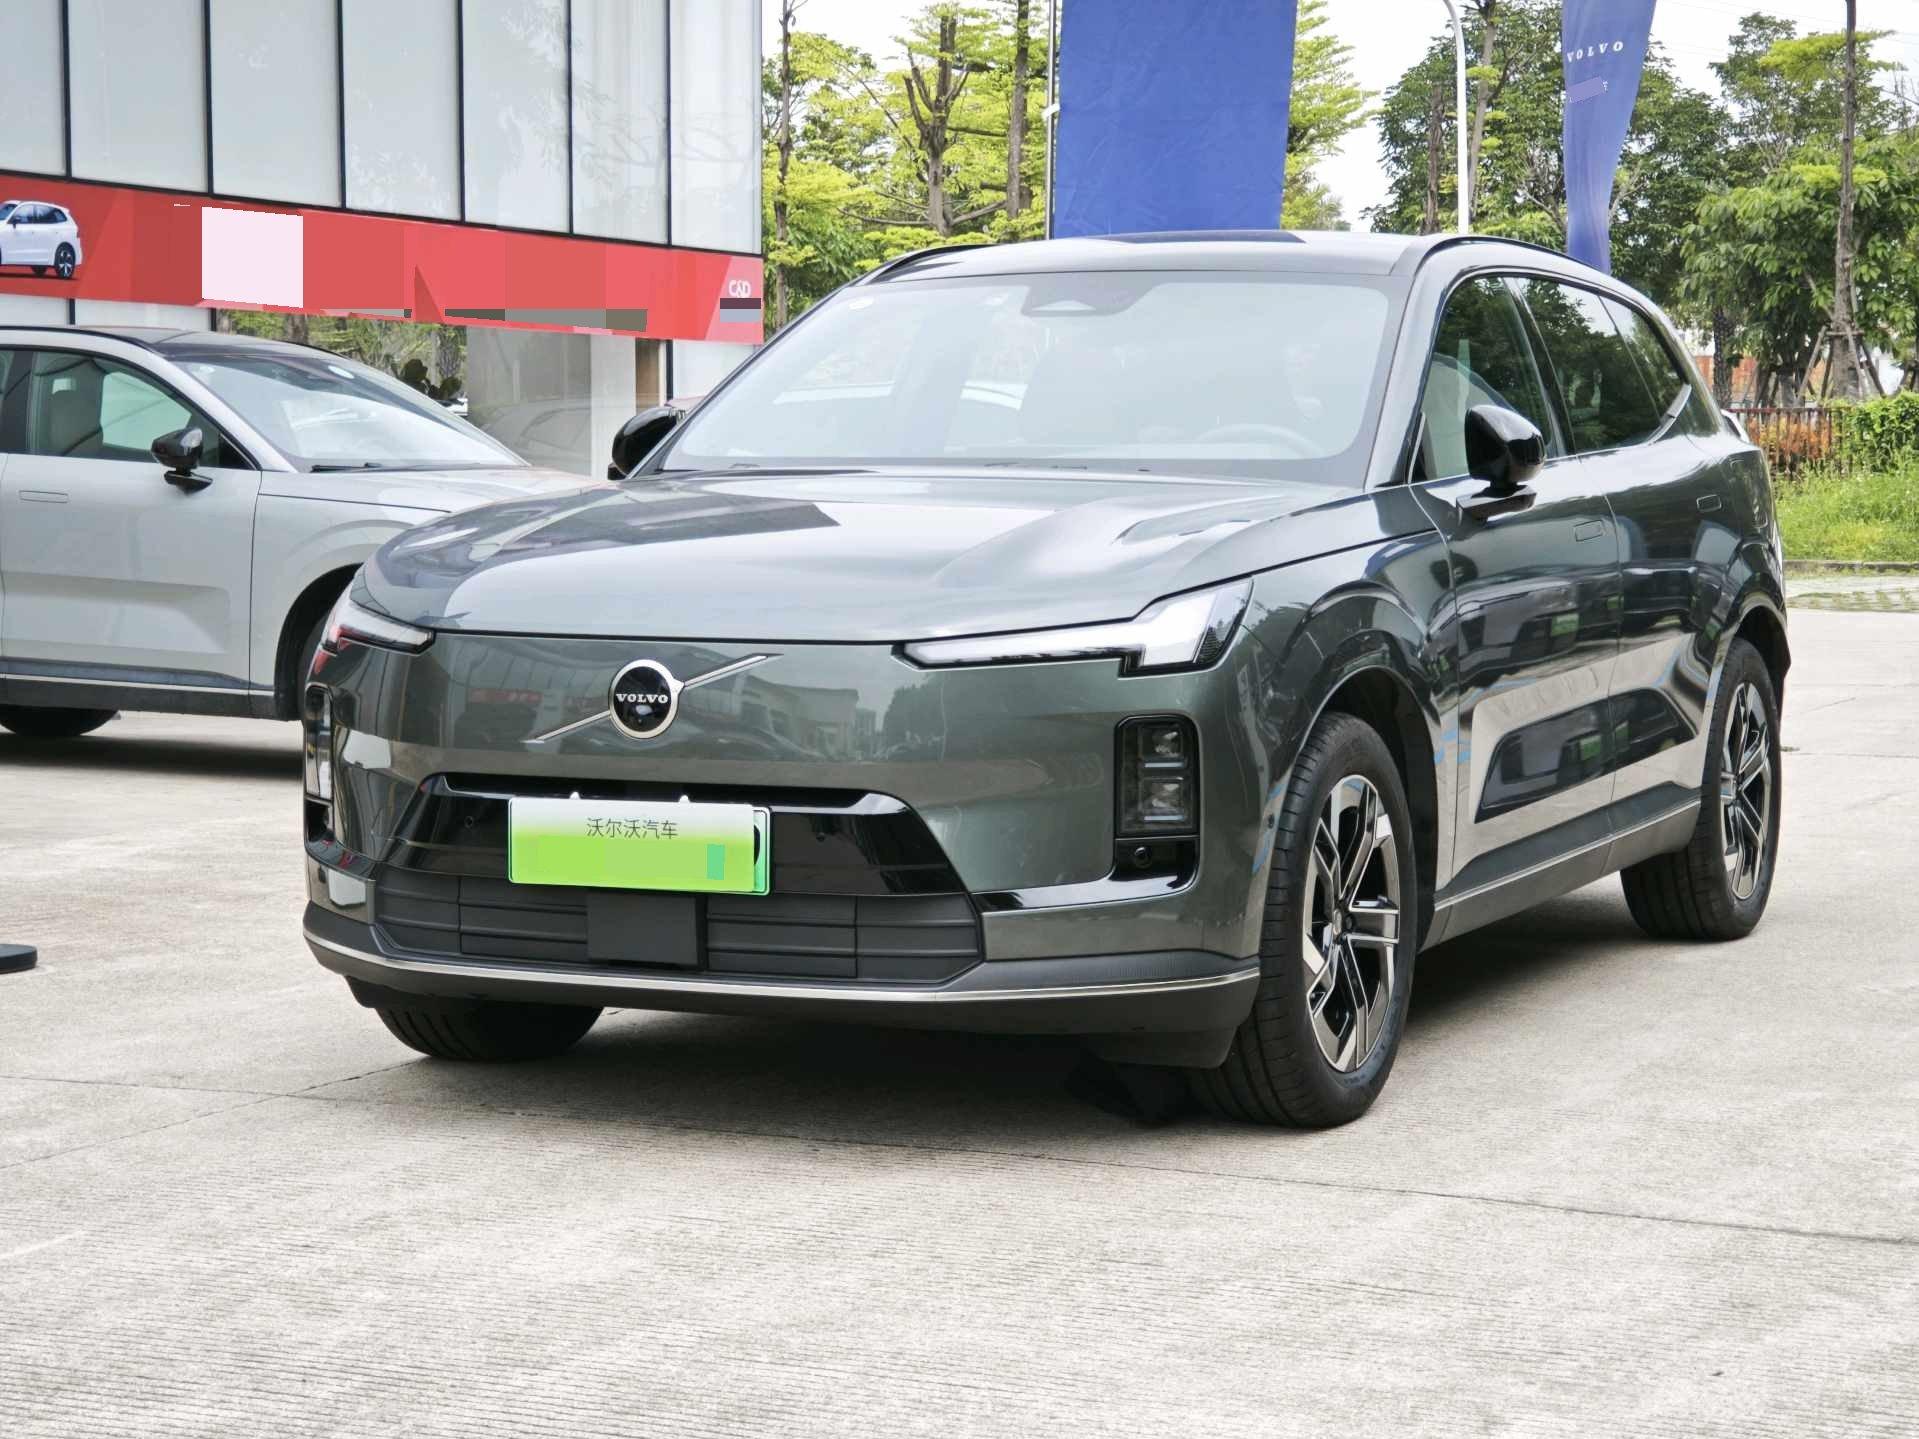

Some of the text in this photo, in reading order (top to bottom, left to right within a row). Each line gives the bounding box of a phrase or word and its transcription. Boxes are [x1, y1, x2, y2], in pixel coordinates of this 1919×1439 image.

[1566, 40, 1624, 63] VOLVO
[615, 693, 669, 704] VOLVO
[586, 817, 679, 840] 沃尔沃汽车
